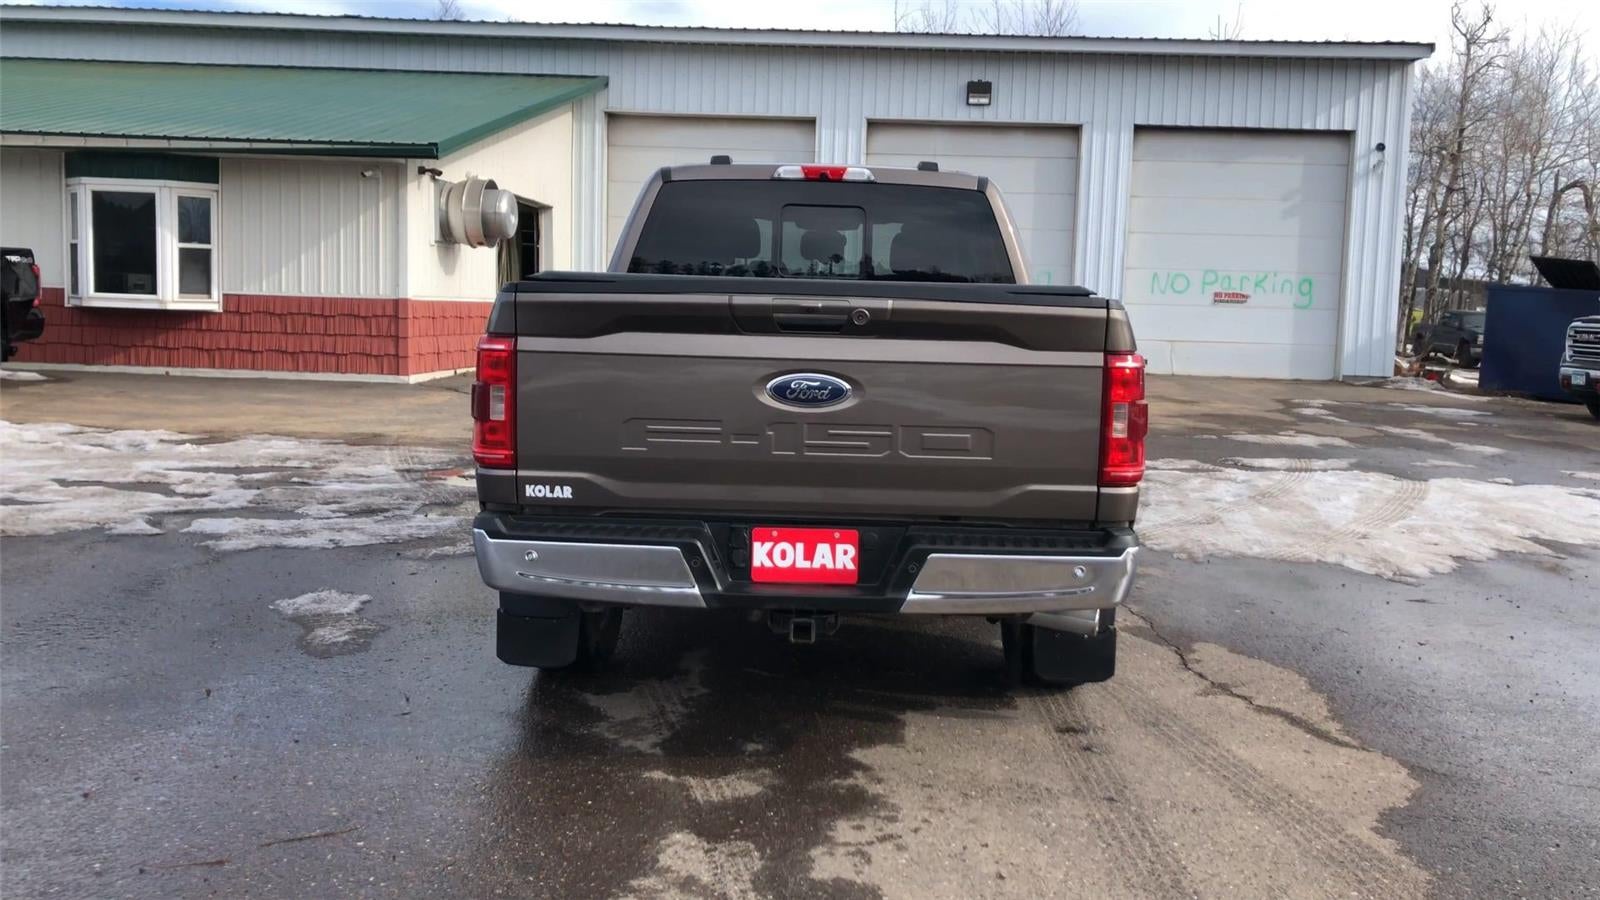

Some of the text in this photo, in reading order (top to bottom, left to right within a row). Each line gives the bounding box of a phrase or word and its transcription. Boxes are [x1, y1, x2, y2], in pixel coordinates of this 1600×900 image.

[1151, 272, 1190, 295] NO
[786, 380, 832, 399] Ford
[622, 418, 994, 460] F-150
[525, 484, 573, 499] KOLAR
[753, 541, 856, 570] KOLAR
